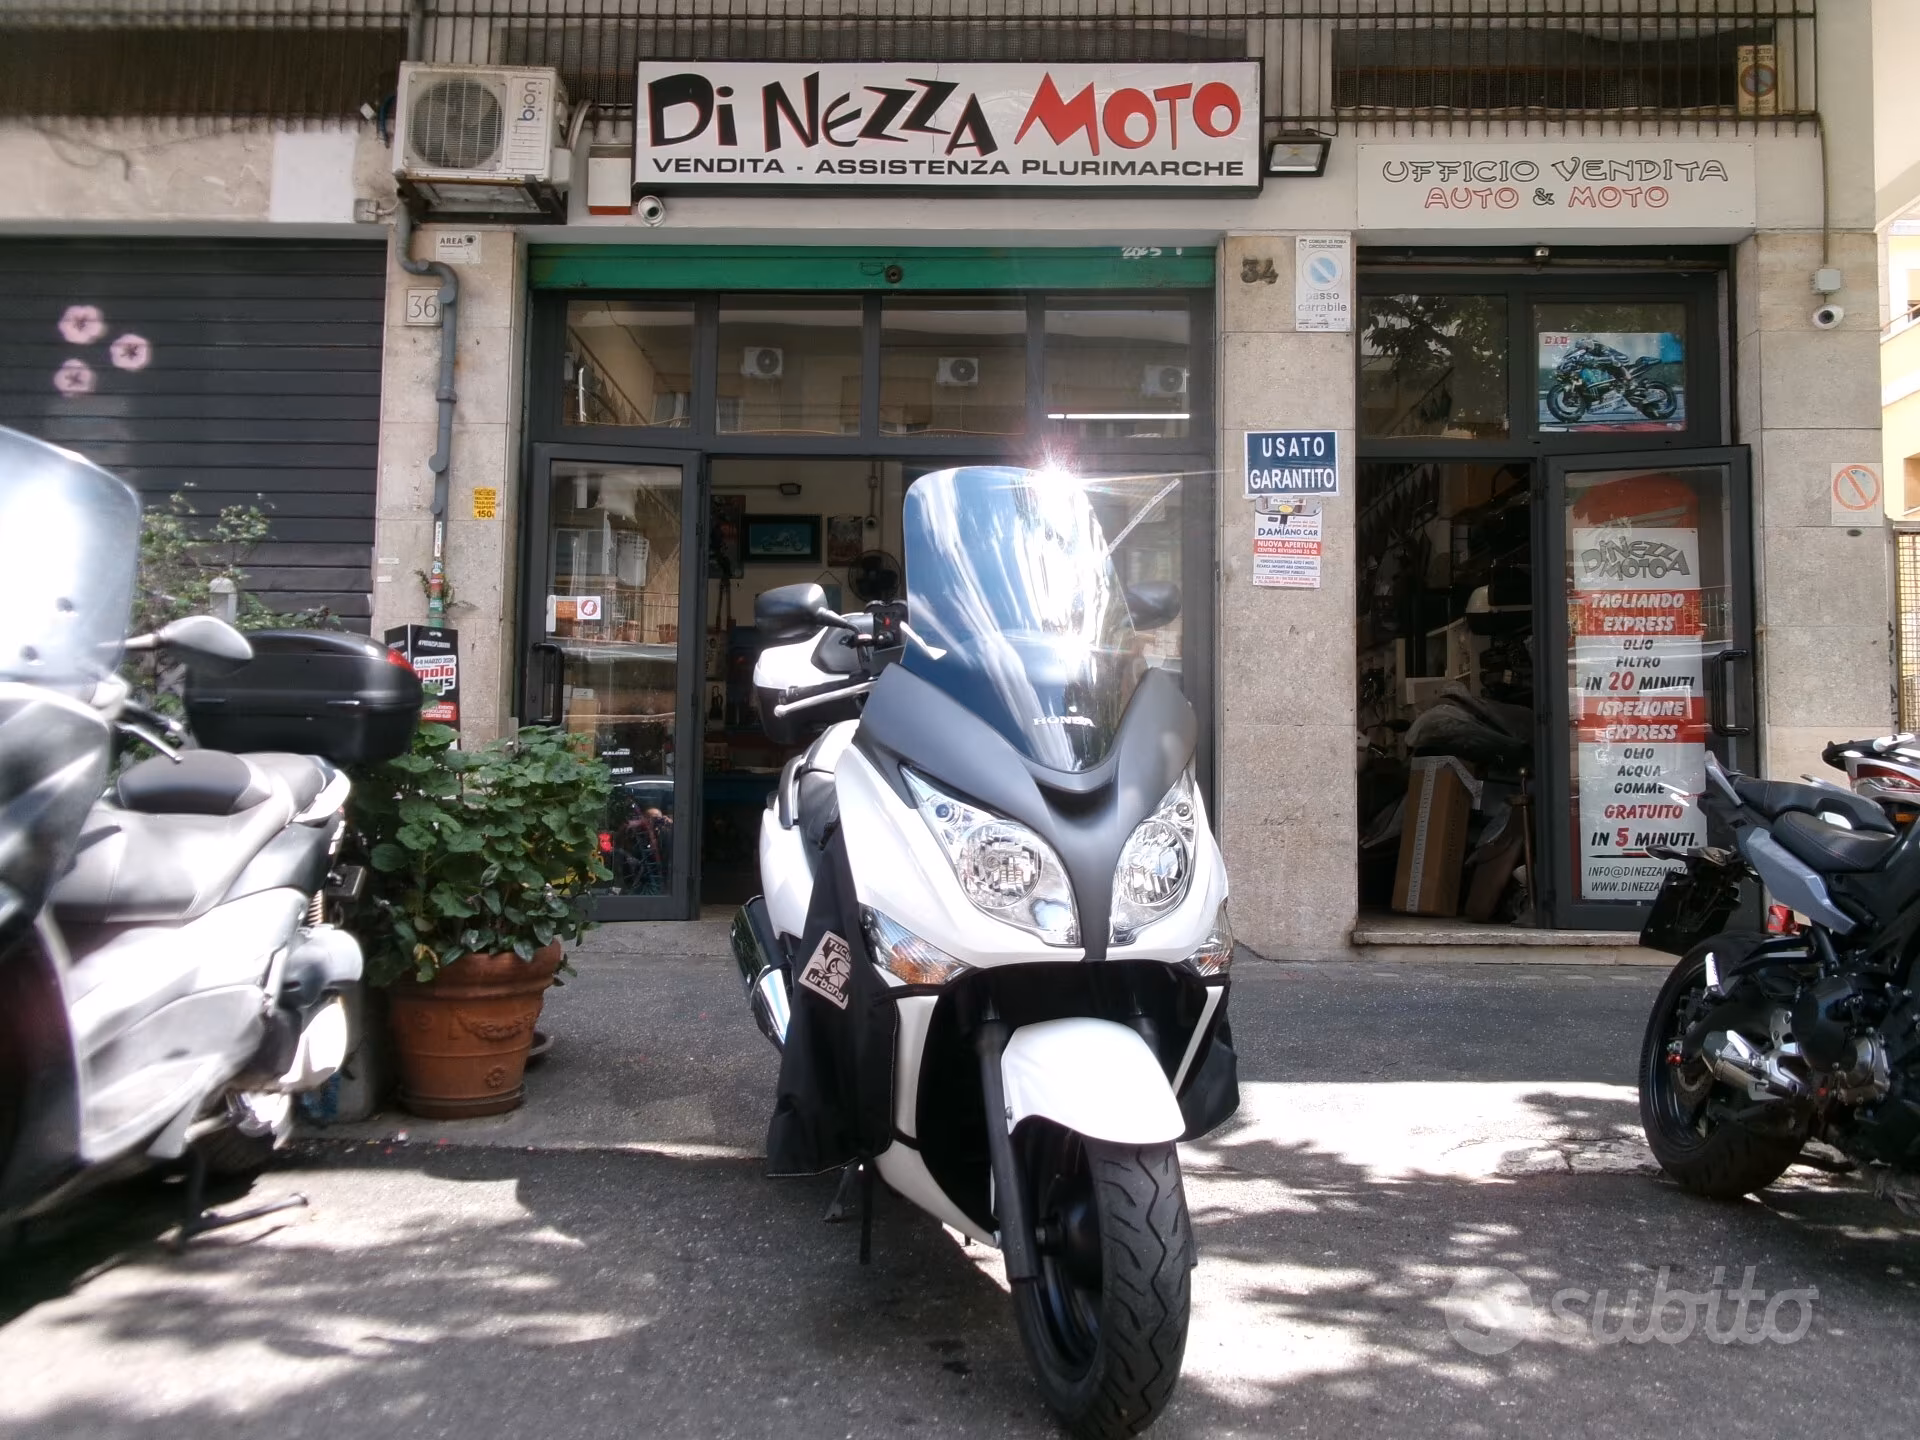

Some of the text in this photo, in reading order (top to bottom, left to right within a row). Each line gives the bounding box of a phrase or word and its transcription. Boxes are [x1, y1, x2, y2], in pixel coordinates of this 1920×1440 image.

[517, 81, 537, 122] bion
[1014, 71, 1241, 157] MOTO
[652, 157, 785, 174] VENDITA
[814, 159, 1010, 175] ASSISTENZA
[1022, 159, 1244, 177] PLURIMARCHE
[1382, 157, 1729, 182] UFFICIO VENDITA
[1424, 186, 1669, 209] AUTO & MOTO
[440, 237, 463, 245] AREA
[1305, 292, 1340, 303] passo
[409, 295, 437, 318] 36
[1297, 302, 1347, 312] carrabile
[1262, 437, 1325, 457] USATO
[1250, 468, 1335, 489] GARANTITO
[1257, 528, 1302, 536] DAMIANO
[1257, 540, 1318, 549] NUOVA APERTURA
[1600, 557, 1668, 581] MOTO
[1591, 593, 1685, 609] TAGLIANDO
[1603, 616, 1675, 632] EXPRESS
[1623, 639, 1654, 651] OLIO
[1616, 656, 1661, 668] FILTRO
[1585, 671, 1695, 691] IN 20 MINUTI
[1596, 701, 1685, 716] ISPEZIONE
[1033, 715, 1096, 728] HONDA
[1605, 724, 1679, 740] EXPRESS
[1623, 748, 1655, 759] OLIO
[1617, 765, 1661, 777] ACQUA
[1614, 782, 1665, 794] GOMME
[1604, 804, 1684, 820] GRATUITO
[1591, 832, 1610, 846] IN
[1615, 827, 1630, 847] 5
[1591, 881, 1661, 892] WWW.DINEZZA
[808, 974, 845, 1001] urbano
